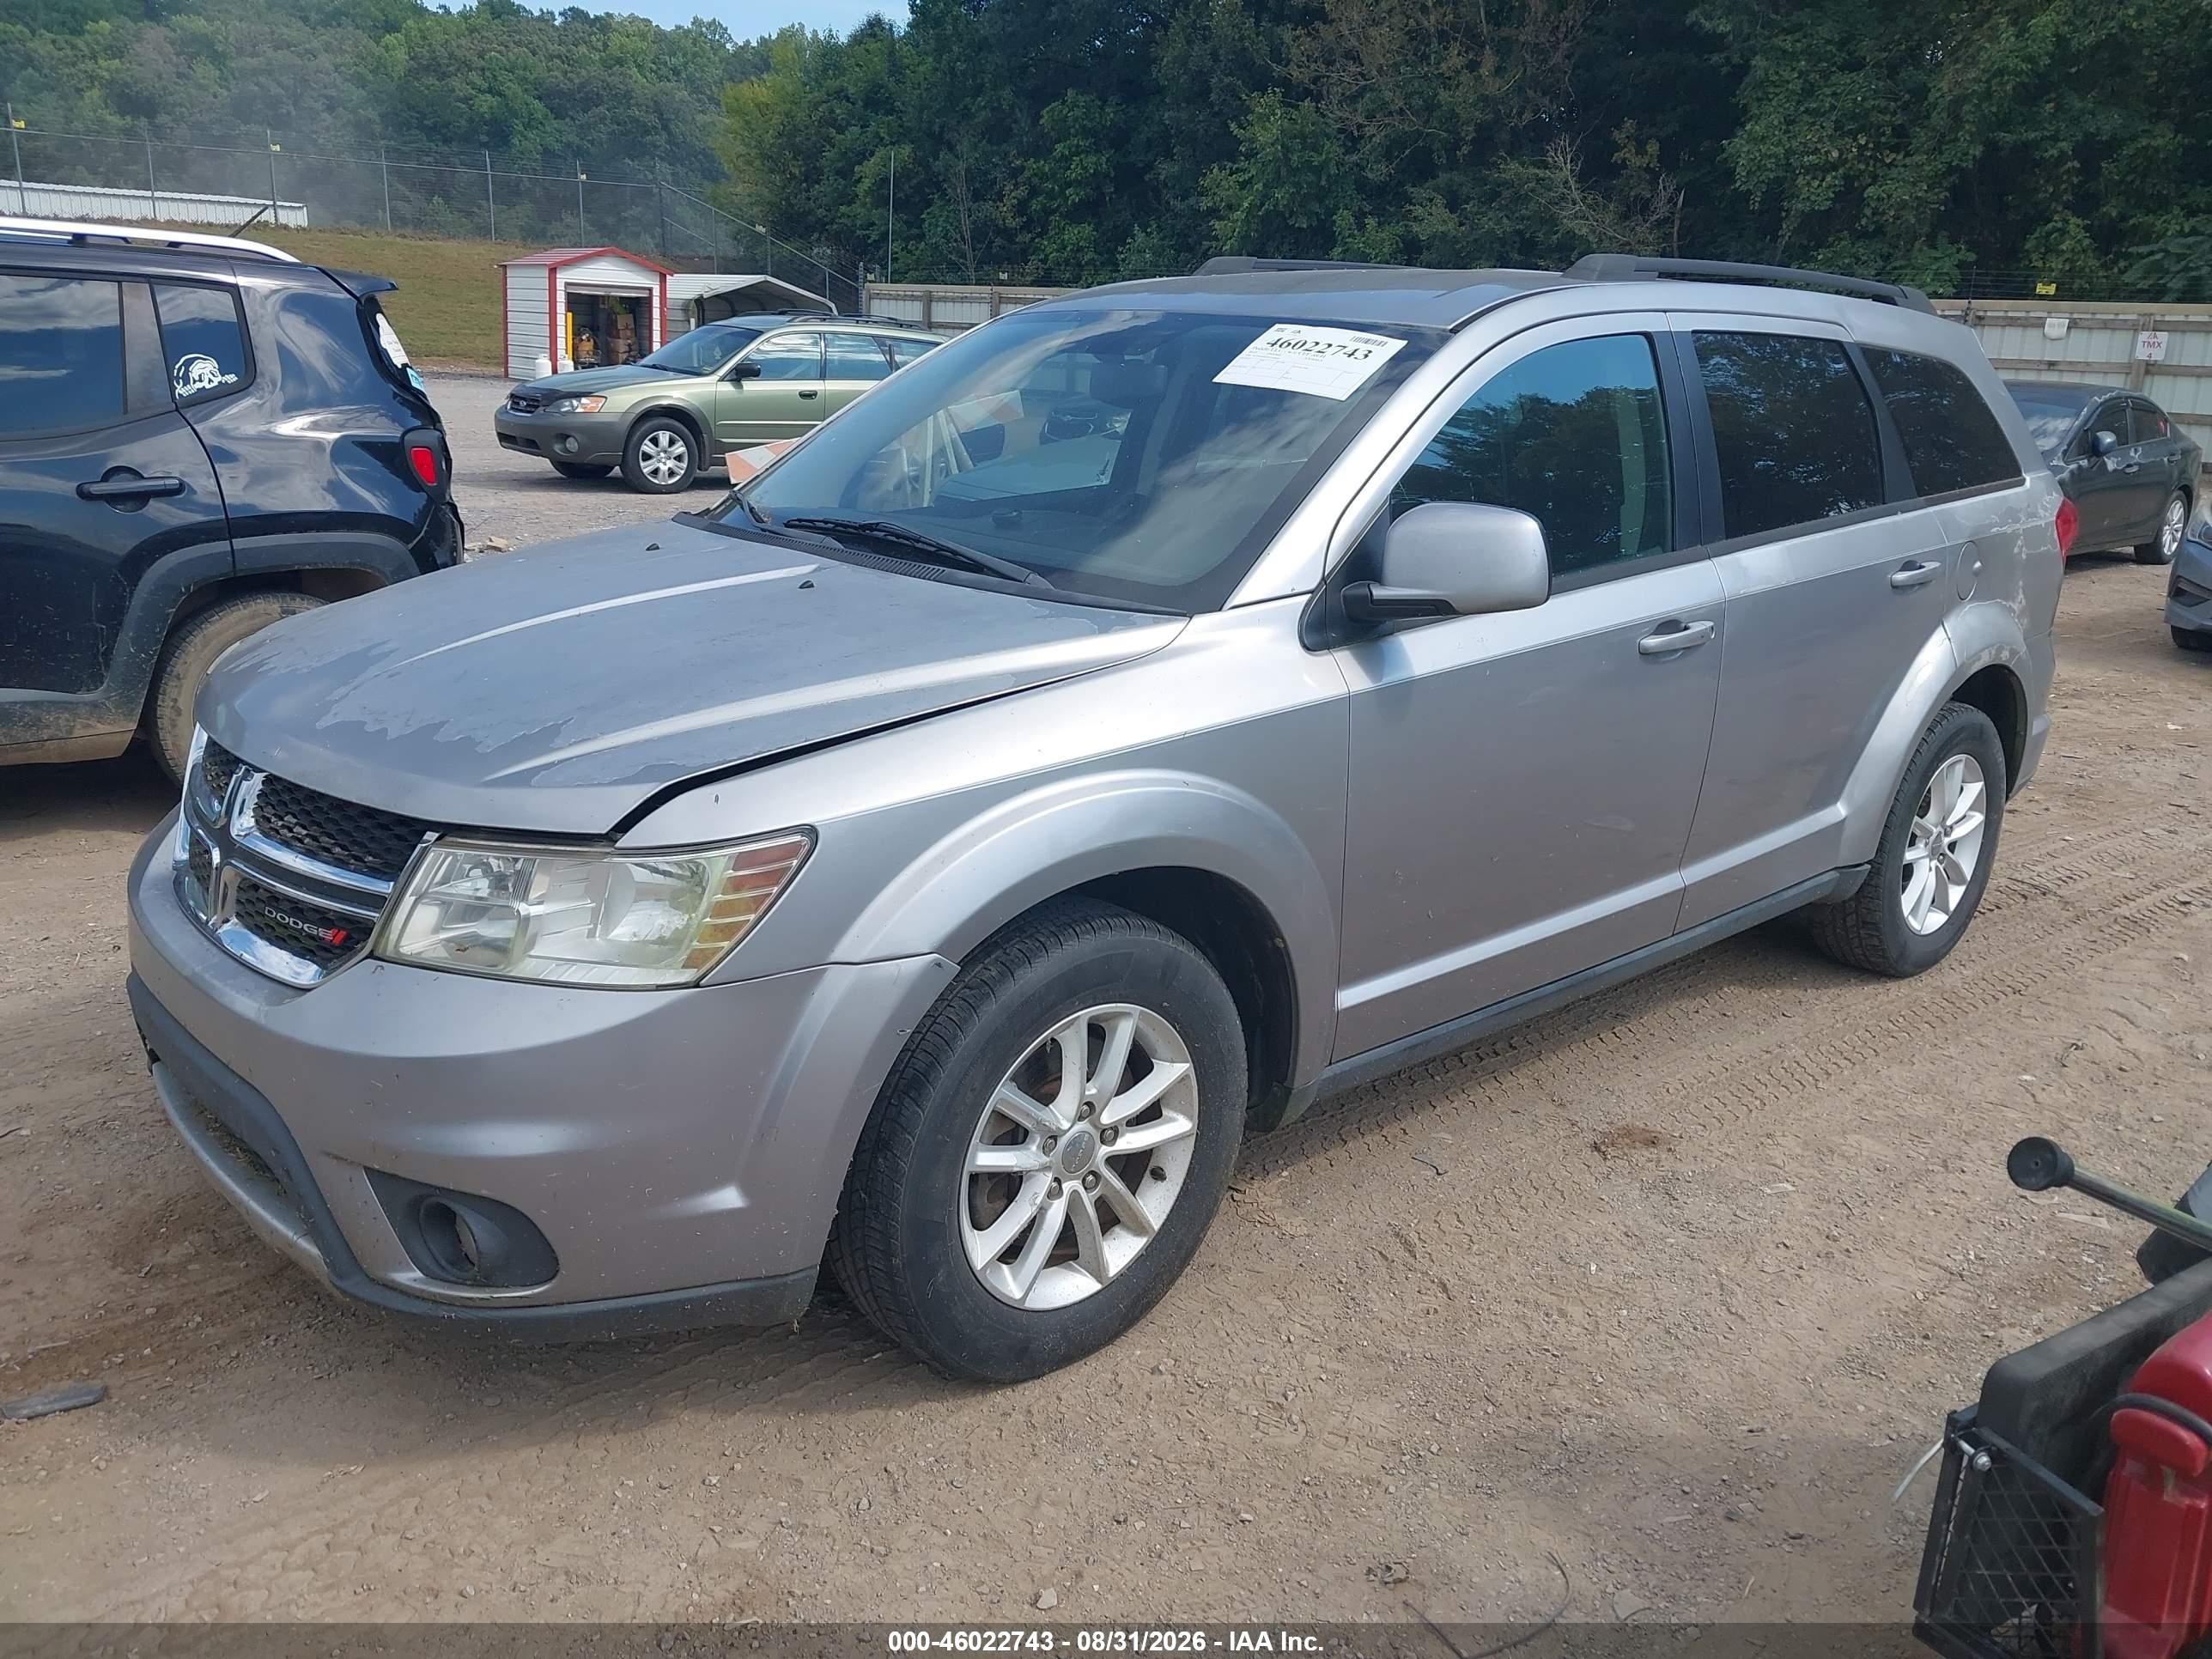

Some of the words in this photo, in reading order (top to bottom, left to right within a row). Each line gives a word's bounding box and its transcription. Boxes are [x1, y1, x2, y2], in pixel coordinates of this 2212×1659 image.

[1267, 337, 1373, 361] 46022743
[2142, 340, 2162, 349] TMX
[264, 906, 334, 942] DODGE
